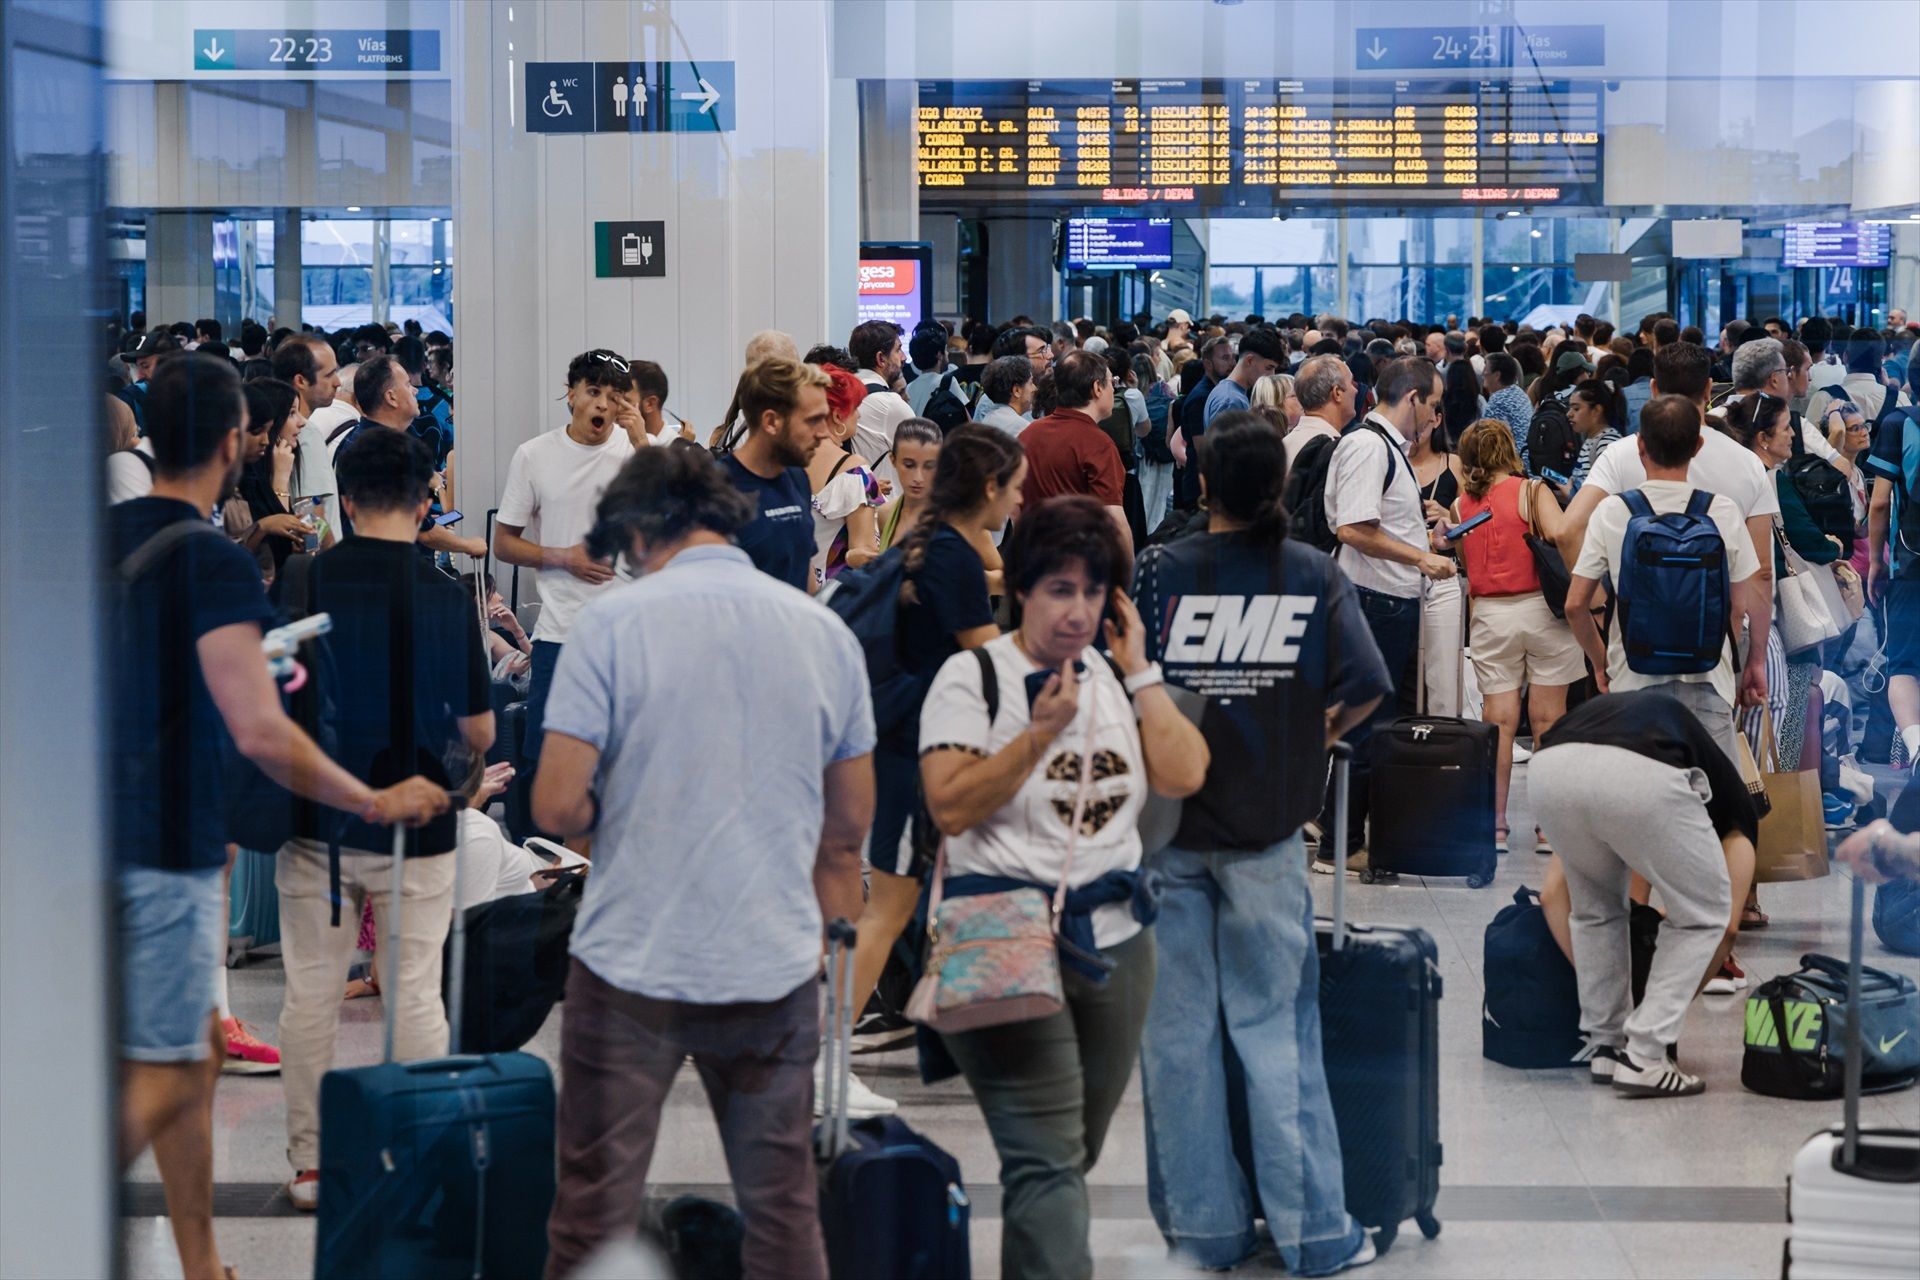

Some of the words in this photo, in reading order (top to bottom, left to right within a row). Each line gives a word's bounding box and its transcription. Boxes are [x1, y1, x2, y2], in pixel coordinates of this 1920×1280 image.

[358, 36, 386, 52] Vías
[357, 54, 403, 64] PLATFORMS
[1521, 50, 1568, 59] PLATFORMS
[562, 79, 578, 88] WC
[918, 108, 940, 119] IGO
[1124, 107, 1139, 119] 23
[1151, 106, 1210, 118] DISCULPEN
[1394, 106, 1416, 118] AVE
[918, 121, 976, 132] ALLADOLID
[1151, 120, 1210, 132] DISCULPEN
[1279, 120, 1332, 132] VALENCIA
[1394, 120, 1416, 131] AVE
[1028, 134, 1049, 146] AVE
[1151, 134, 1210, 145] DISCULPEN
[1279, 134, 1332, 145] VALENCIA
[1491, 132, 1506, 144] 25
[1544, 132, 1558, 144] DE
[918, 148, 976, 159] ALLADOLID
[1151, 147, 1210, 159] DISCULPEN
[1279, 147, 1332, 158] VALENCIA
[918, 161, 976, 172] ALLADOLID
[1151, 160, 1210, 172] DISCULPEN
[1244, 160, 1278, 171] 21:11
[1279, 160, 1338, 171] SALAMANCA
[1151, 174, 1210, 185] DISCULPEN
[1244, 174, 1278, 184] 21:15
[1279, 174, 1332, 184] VALENCIA
[1102, 188, 1148, 200] SALIDAS
[1462, 188, 1508, 200] SALIDAS
[1829, 267, 1852, 294] 24
[1164, 594, 1317, 662] EME
[1745, 998, 1822, 1050] NIKE
